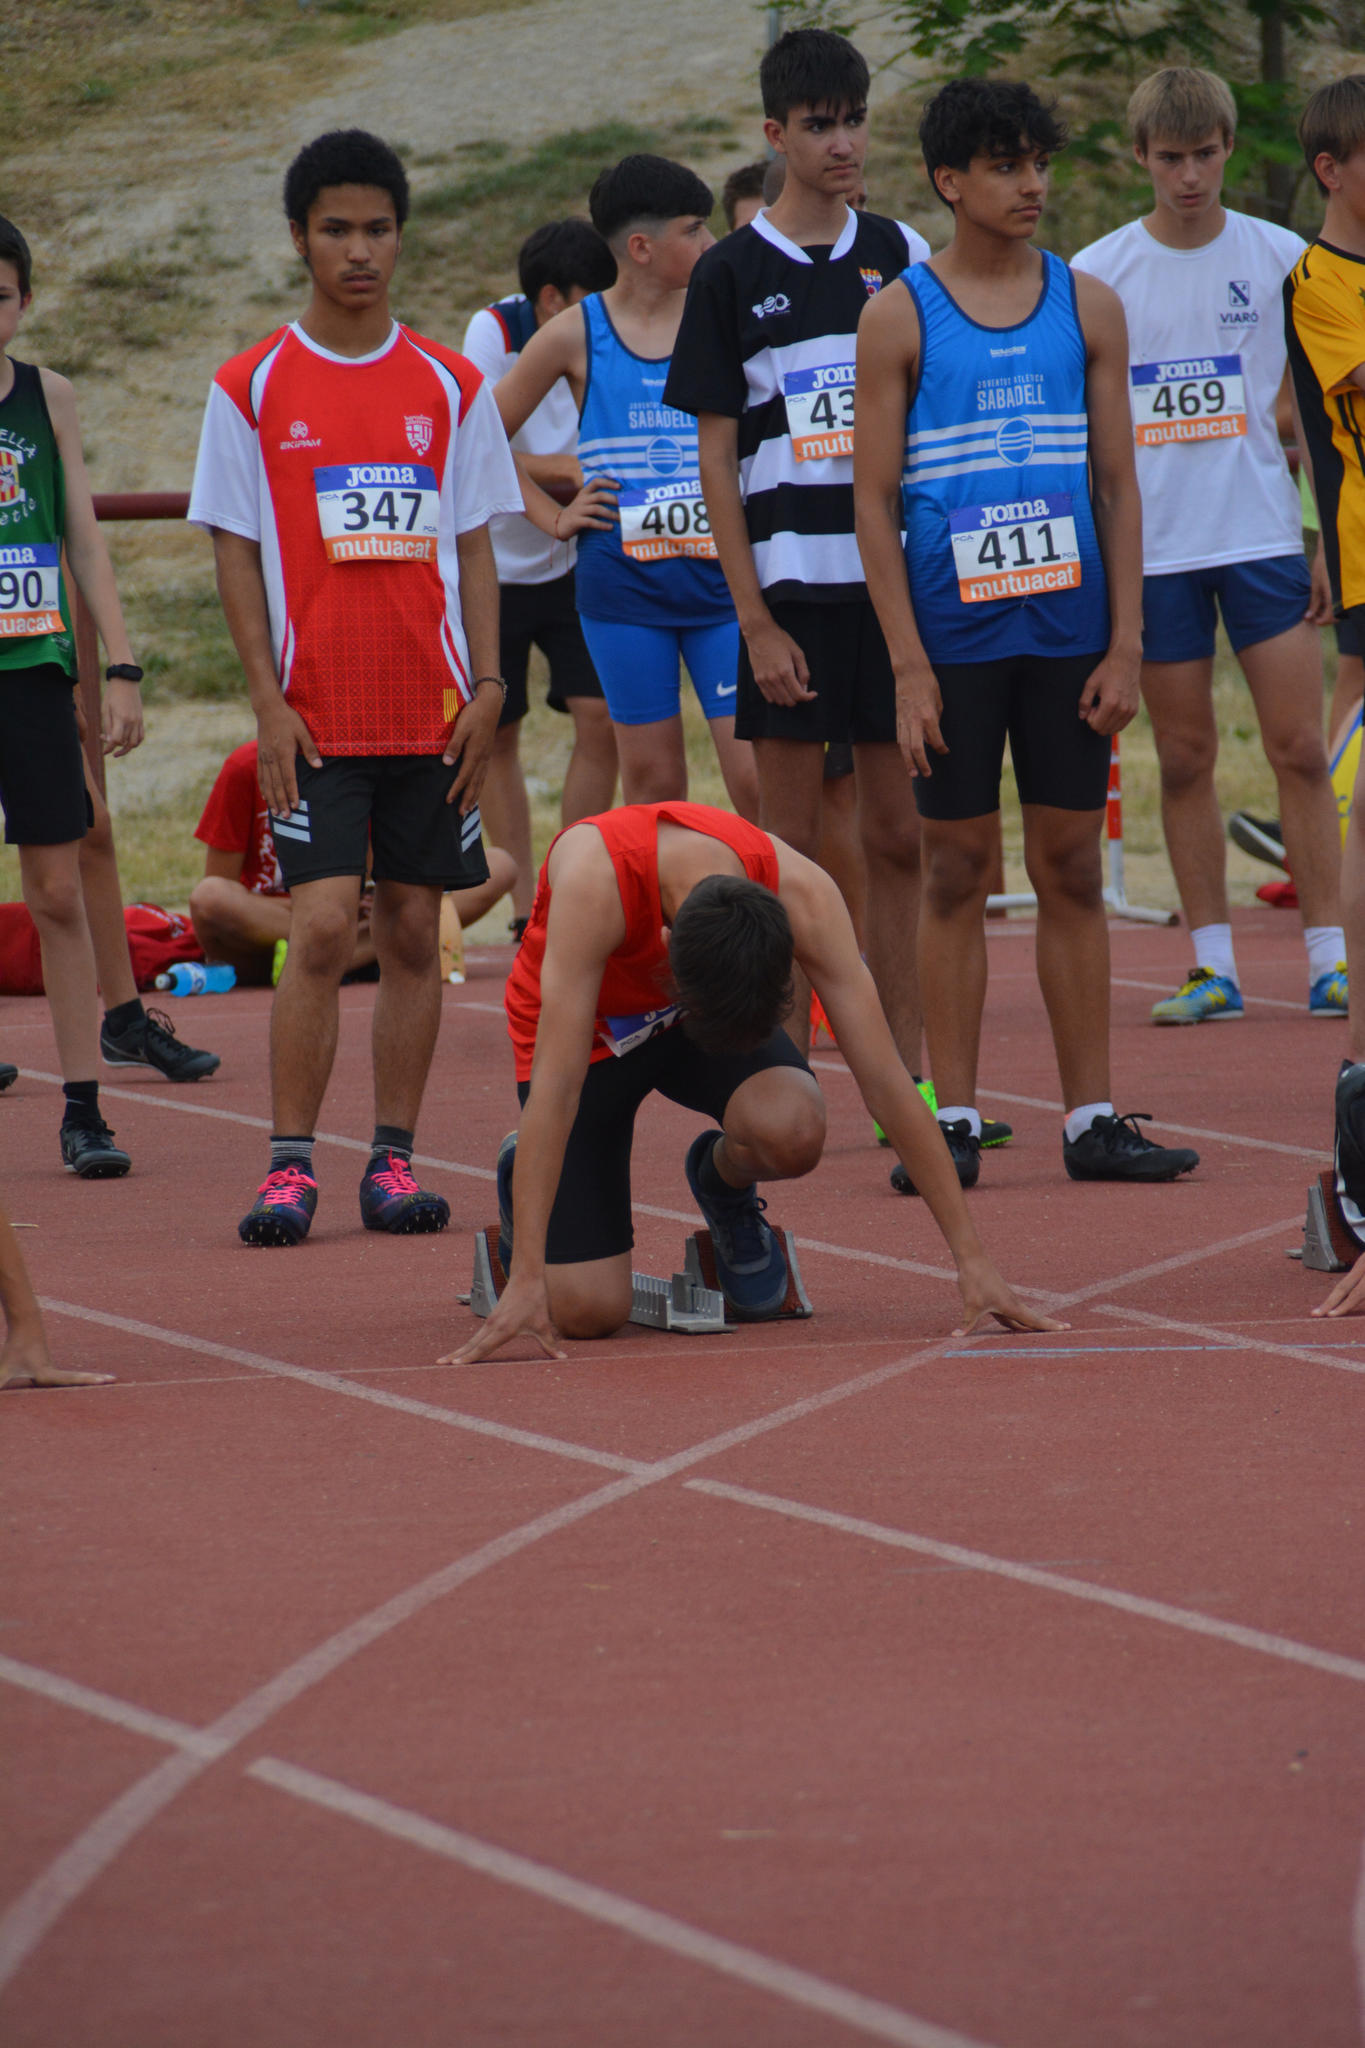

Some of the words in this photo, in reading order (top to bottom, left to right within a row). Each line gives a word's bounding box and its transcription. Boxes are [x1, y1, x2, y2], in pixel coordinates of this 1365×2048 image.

[1155, 359, 1218, 382] Joma
[977, 384, 1046, 411] SABADELL
[1152, 380, 1226, 418] 469
[629, 410, 695, 428] SABADELL
[1144, 417, 1240, 444] mutuacat
[346, 466, 417, 487] Joma
[342, 491, 422, 531] 347
[642, 501, 712, 535] 408
[980, 499, 1050, 528] Joma
[332, 536, 431, 559] mutuacat
[977, 522, 1061, 570] 411
[0, 570, 42, 610] 90
[970, 565, 1075, 599] mutuacat
